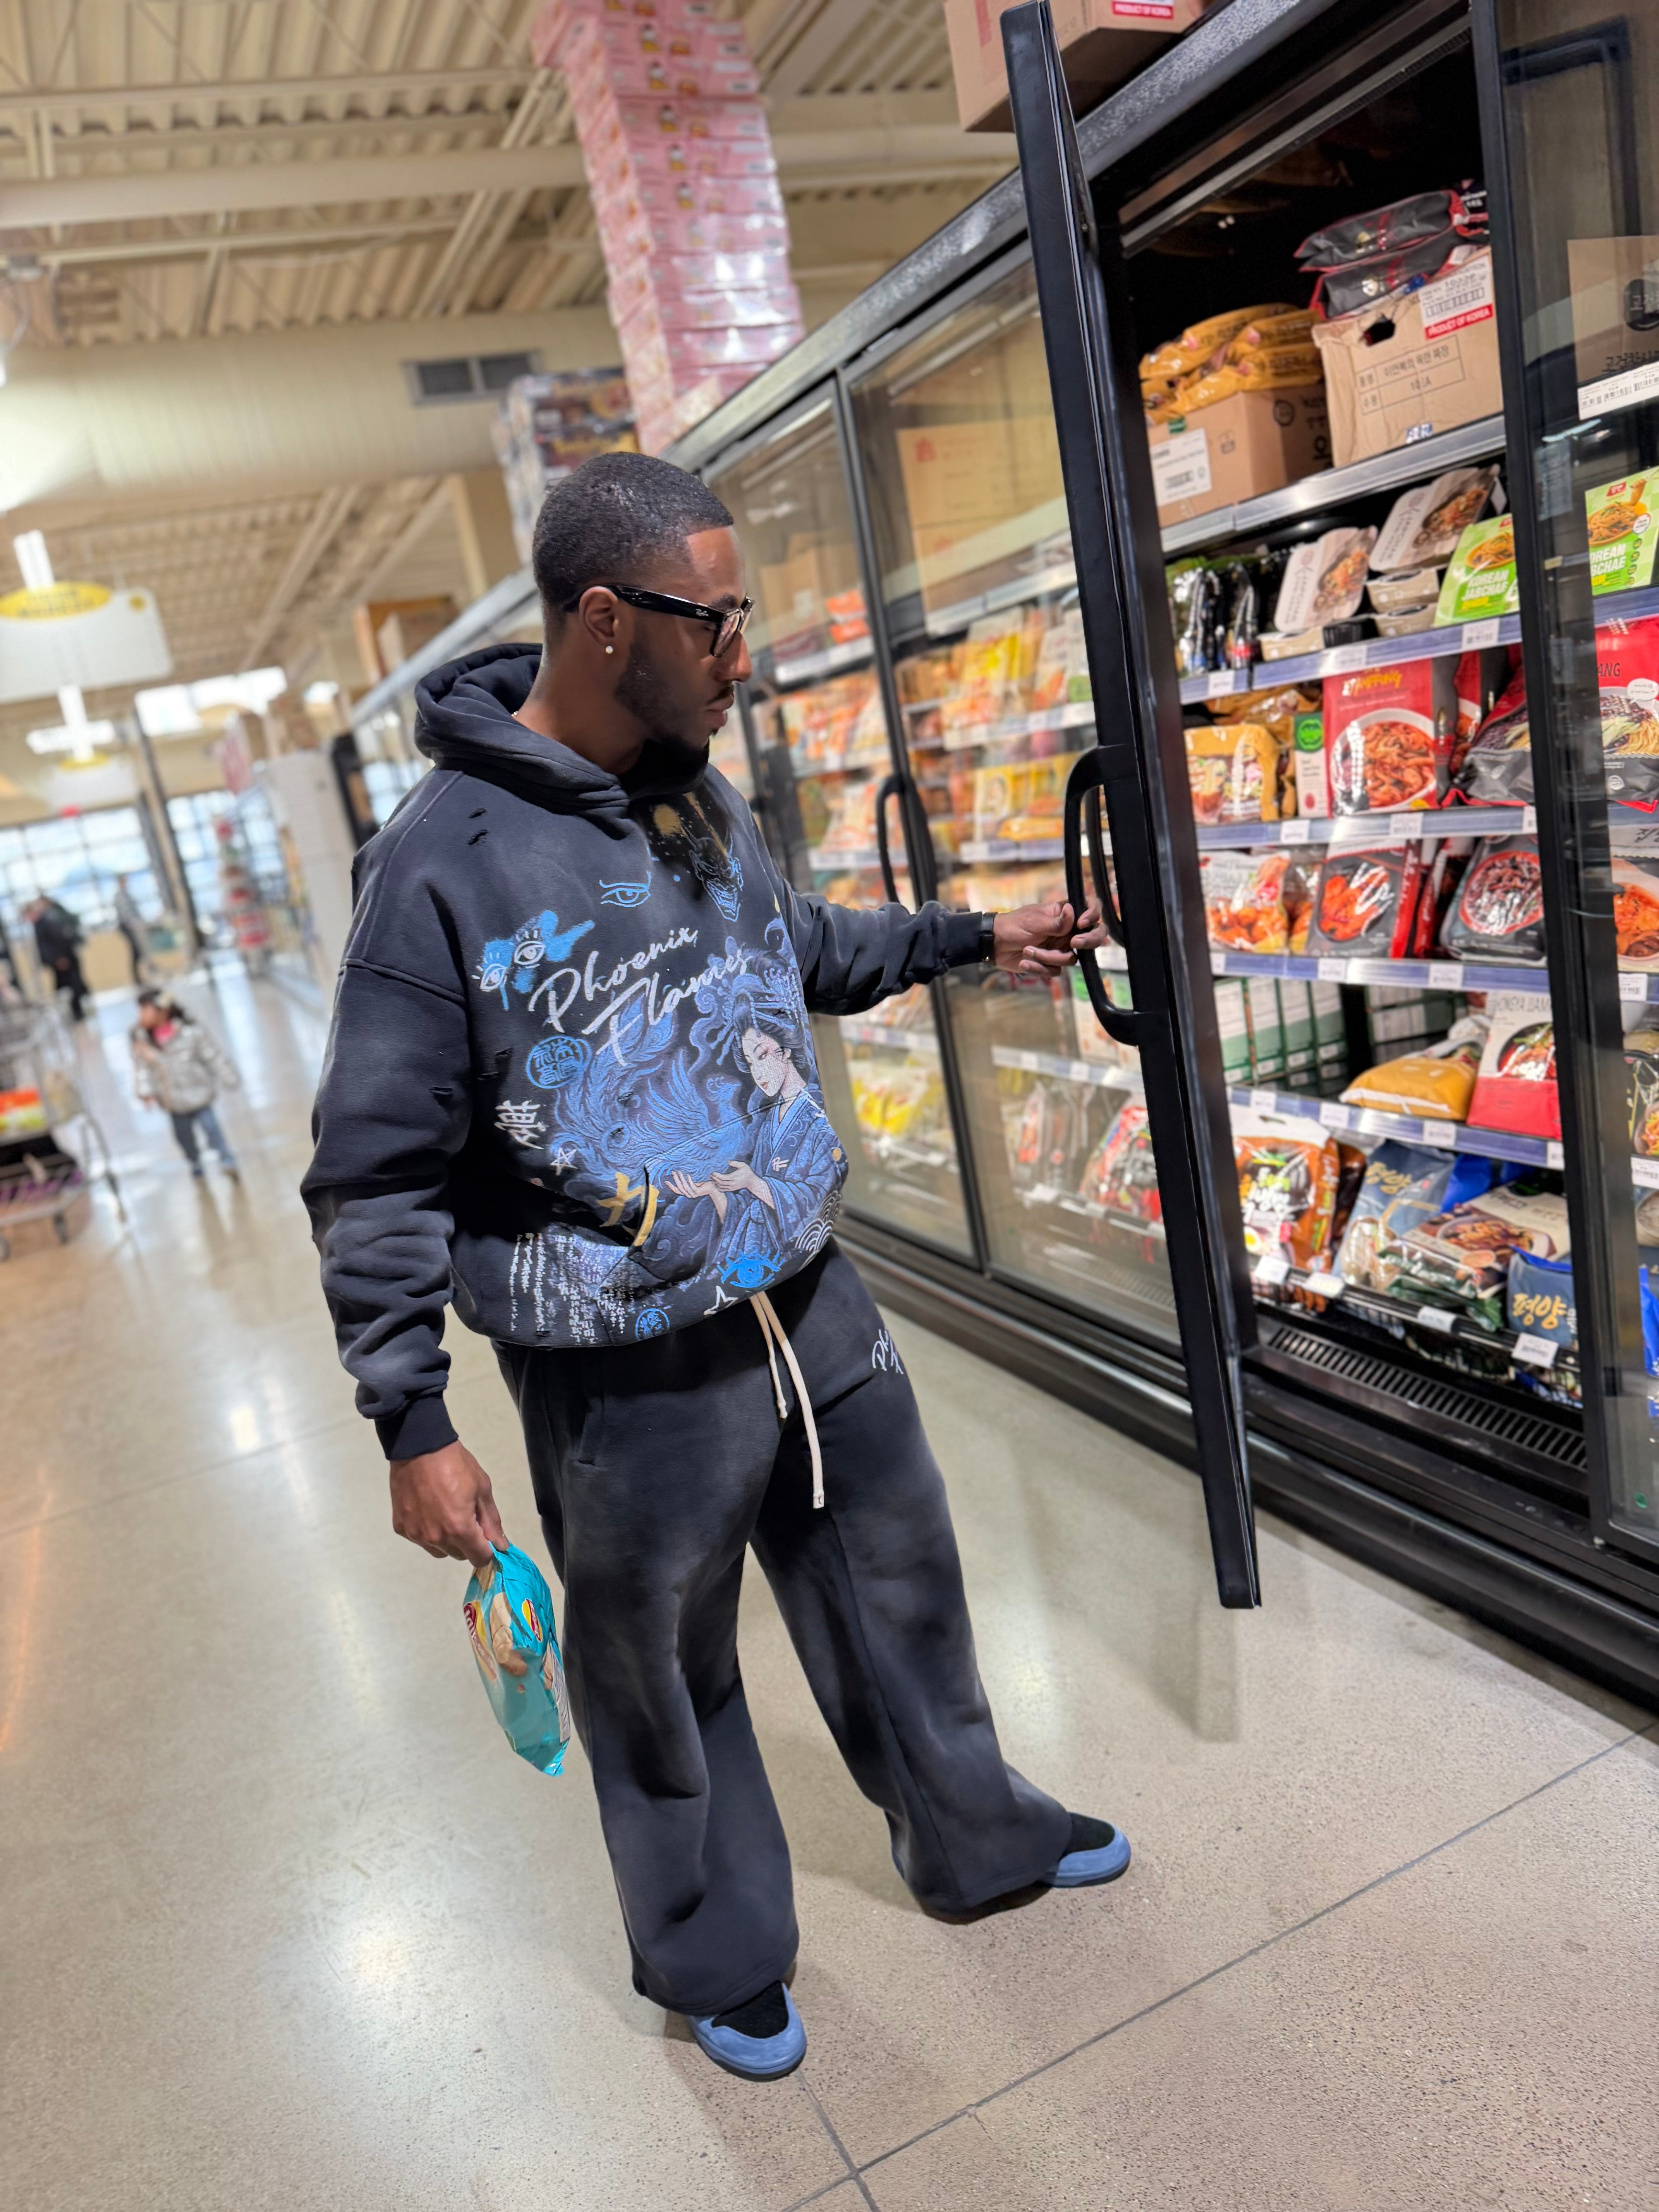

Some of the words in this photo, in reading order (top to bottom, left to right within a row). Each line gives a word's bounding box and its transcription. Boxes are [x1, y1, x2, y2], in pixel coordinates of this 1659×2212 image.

[1428, 319, 1456, 337] PRODUCT
[1457, 315, 1466, 326] OF
[1466, 307, 1490, 322] KOREA
[1590, 543, 1626, 563] OREAN
[1590, 556, 1626, 575] BCHAE
[1467, 570, 1510, 587] KOREAN
[528, 927, 699, 1033] Phoenix
[581, 948, 754, 1066] Flames
[1512, 1293, 1568, 1330] 평양
